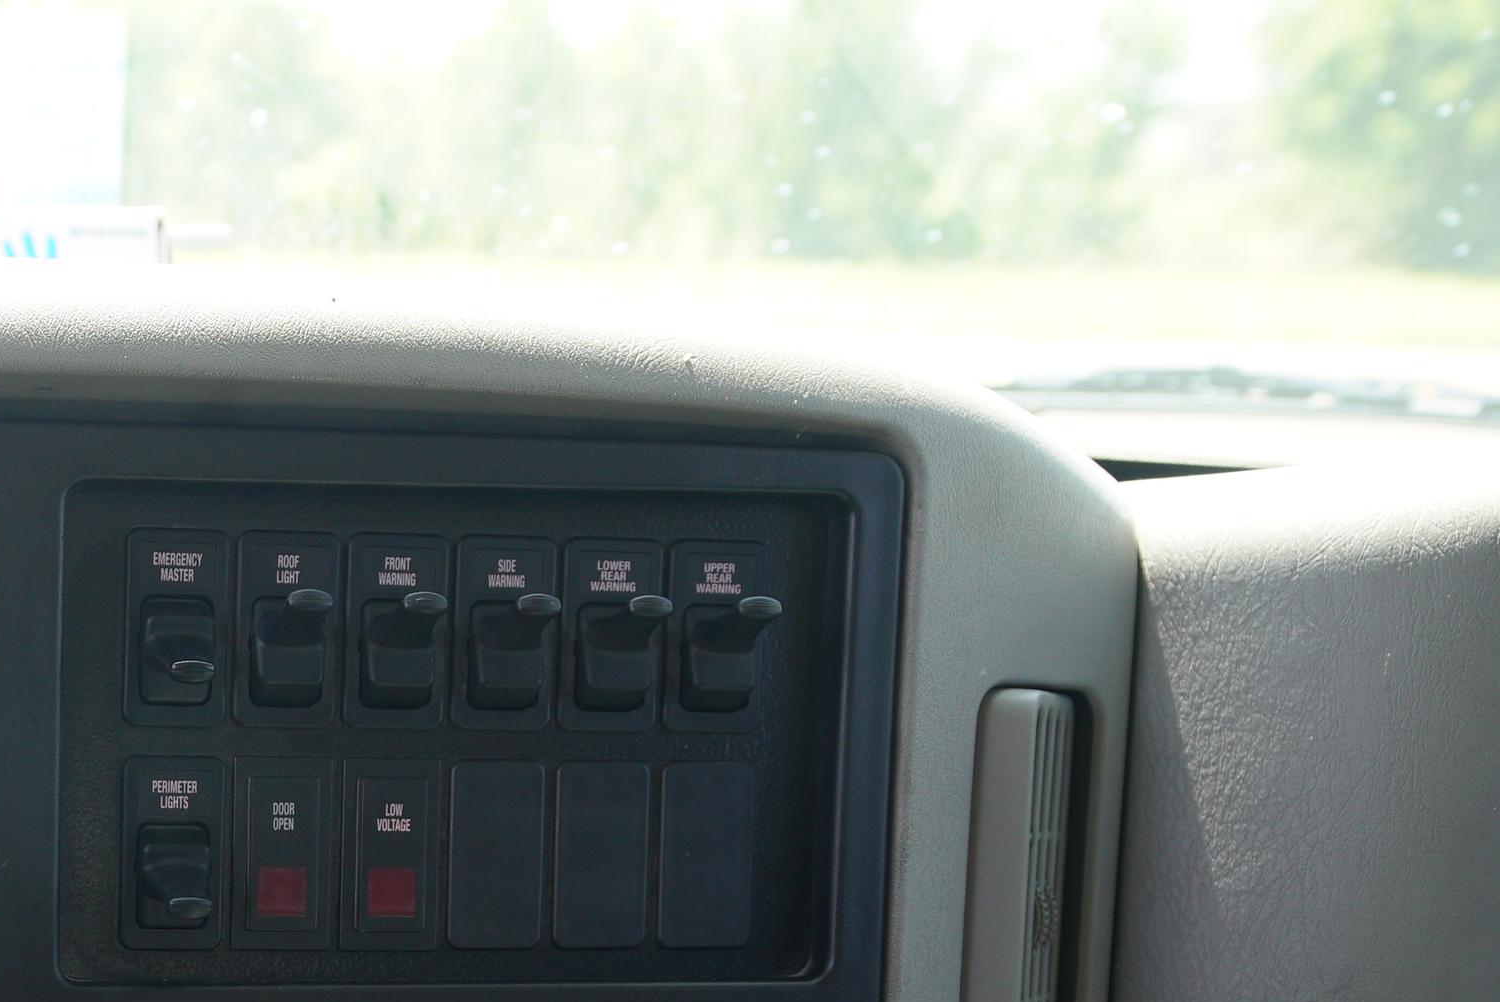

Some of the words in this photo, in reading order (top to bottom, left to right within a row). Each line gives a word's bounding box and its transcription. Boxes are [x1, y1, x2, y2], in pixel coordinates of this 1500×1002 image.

[153, 552, 203, 566] EMERGENCY
[277, 554, 300, 568] ROOF
[384, 556, 411, 570] FRONT
[498, 559, 516, 573] SIDE
[597, 560, 631, 572] LOWER
[160, 568, 194, 582] MASTER
[704, 562, 735, 574] UPPER
[276, 570, 300, 584] LIGHT
[378, 572, 416, 586] WARNING
[488, 574, 526, 588] WARNING
[601, 570, 627, 582] REAR
[706, 572, 732, 584] REAR
[590, 581, 636, 592] WARNING
[696, 583, 741, 594] WARNING
[152, 780, 198, 794] PERIMETER
[160, 795, 189, 809] LIGHTS
[272, 801, 295, 815] DOOR
[385, 803, 404, 817] LOW
[272, 817, 295, 831] OPEN
[377, 818, 411, 832] VOLTAGE
